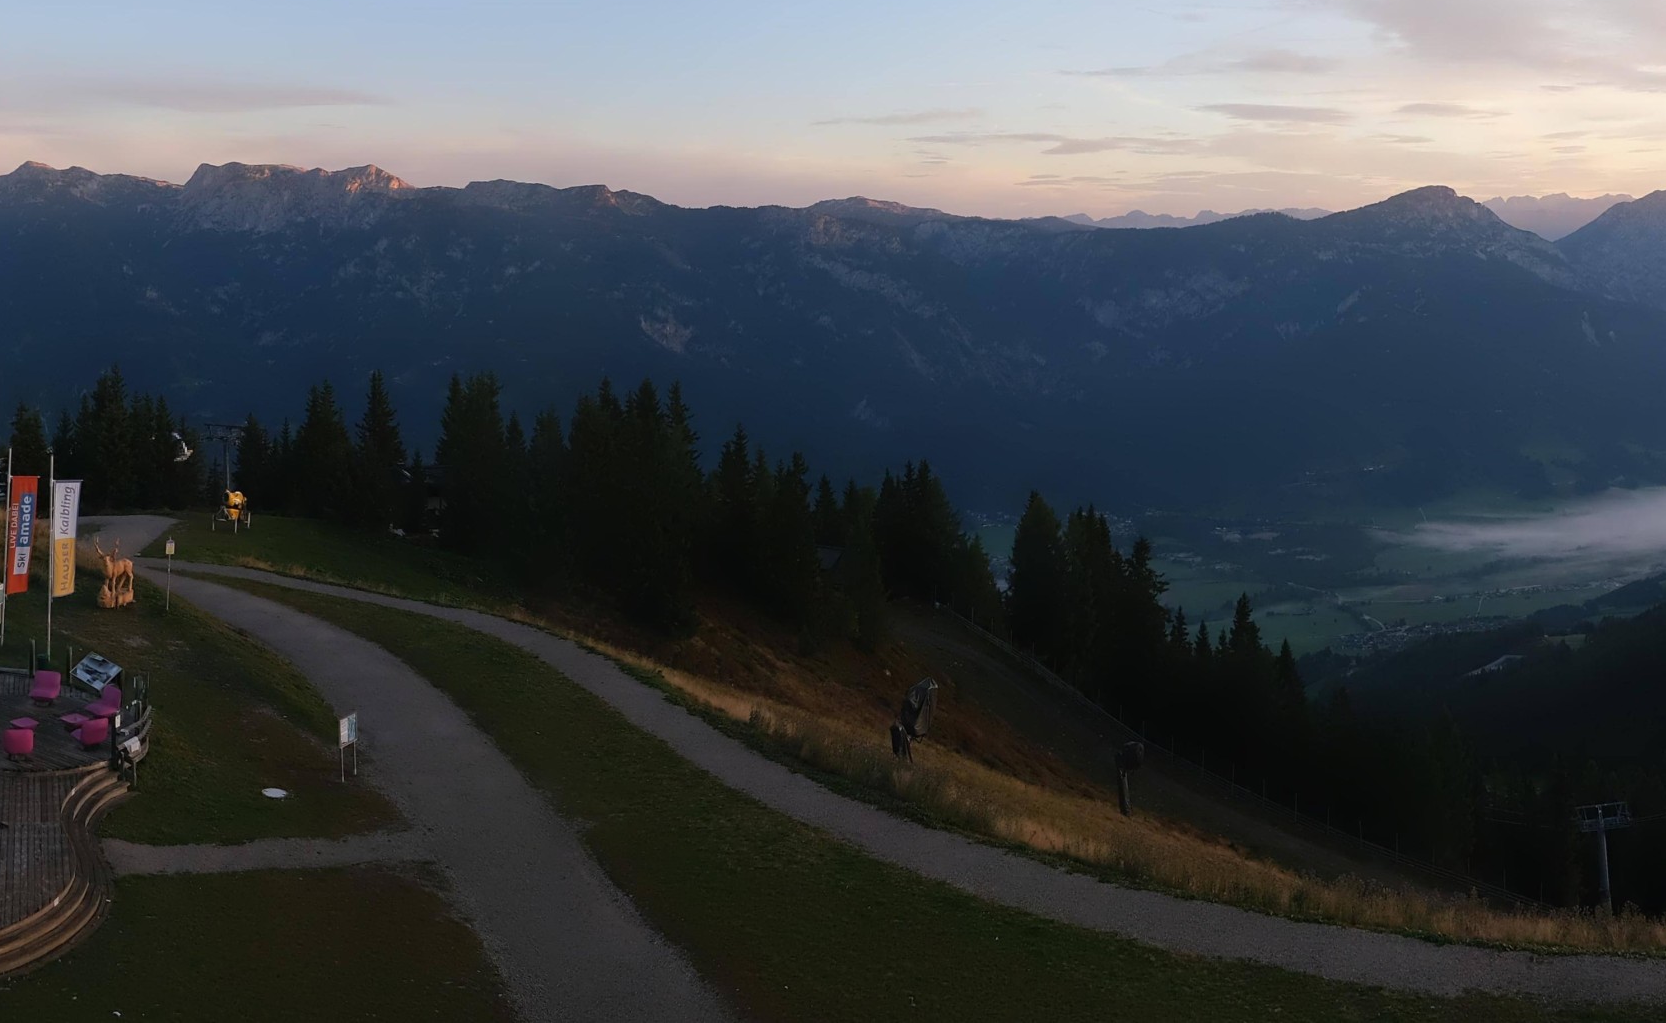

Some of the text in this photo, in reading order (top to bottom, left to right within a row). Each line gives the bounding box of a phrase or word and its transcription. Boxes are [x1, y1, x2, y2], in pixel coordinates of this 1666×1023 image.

[11, 503, 19, 528] DABEI
[60, 486, 75, 591] HAUSER Kaibling
[17, 552, 27, 568] Ski
